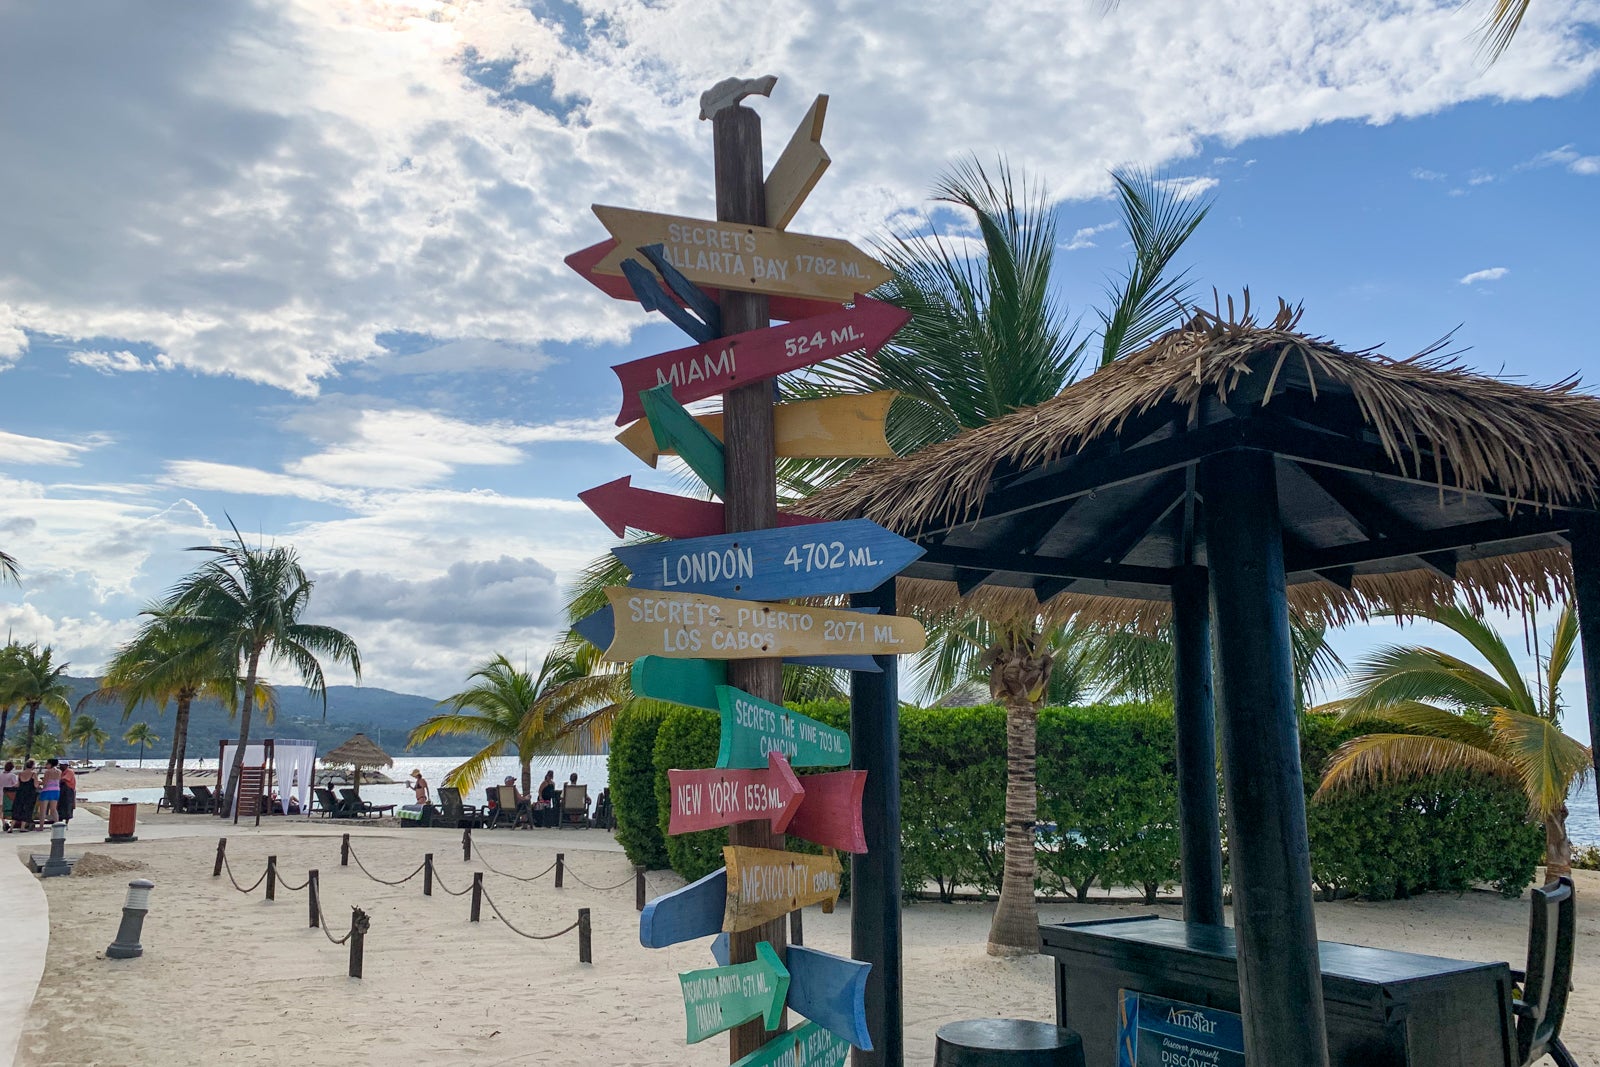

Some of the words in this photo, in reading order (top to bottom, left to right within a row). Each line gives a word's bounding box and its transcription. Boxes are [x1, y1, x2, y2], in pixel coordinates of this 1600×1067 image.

[668, 223, 757, 253] SECRETS
[662, 246, 746, 276] ALLARTA
[752, 256, 788, 280] BAY
[795, 255, 837, 276] 1782
[841, 262, 871, 279] ML.
[656, 347, 736, 387] MIAMI
[785, 331, 827, 357] 524
[831, 325, 865, 345] ML.
[662, 547, 753, 587] LONDON
[783, 541, 845, 573] 4702
[849, 547, 884, 568] ML.
[628, 597, 720, 627] SECRETS
[737, 608, 813, 632] PUERTO
[824, 620, 865, 643] 2071
[873, 626, 904, 644] ML.
[664, 628, 702, 652] LOS
[711, 630, 775, 650] CABOS
[735, 699, 775, 733] SECRETS
[780, 715, 795, 738] THE
[799, 723, 817, 743] VINE
[819, 731, 833, 752] 703
[760, 735, 798, 758] CANCUN
[678, 783, 702, 816] NEW
[709, 781, 739, 813] YORK
[744, 784, 767, 812] 1553
[768, 787, 786, 809] ML.
[742, 865, 784, 905] MEXICO
[787, 863, 809, 898] CITY
[703, 978, 719, 999] PLAYA
[719, 974, 740, 997] BONITA
[742, 974, 756, 998] 671
[756, 972, 771, 993] ML.
[695, 1001, 724, 1033] PANAMA
[1166, 1006, 1217, 1034] Amstar
[808, 1027, 831, 1062] BEACH
[1161, 1051, 1219, 1067] DISCOV
[1162, 1038, 1189, 1052] Discover
